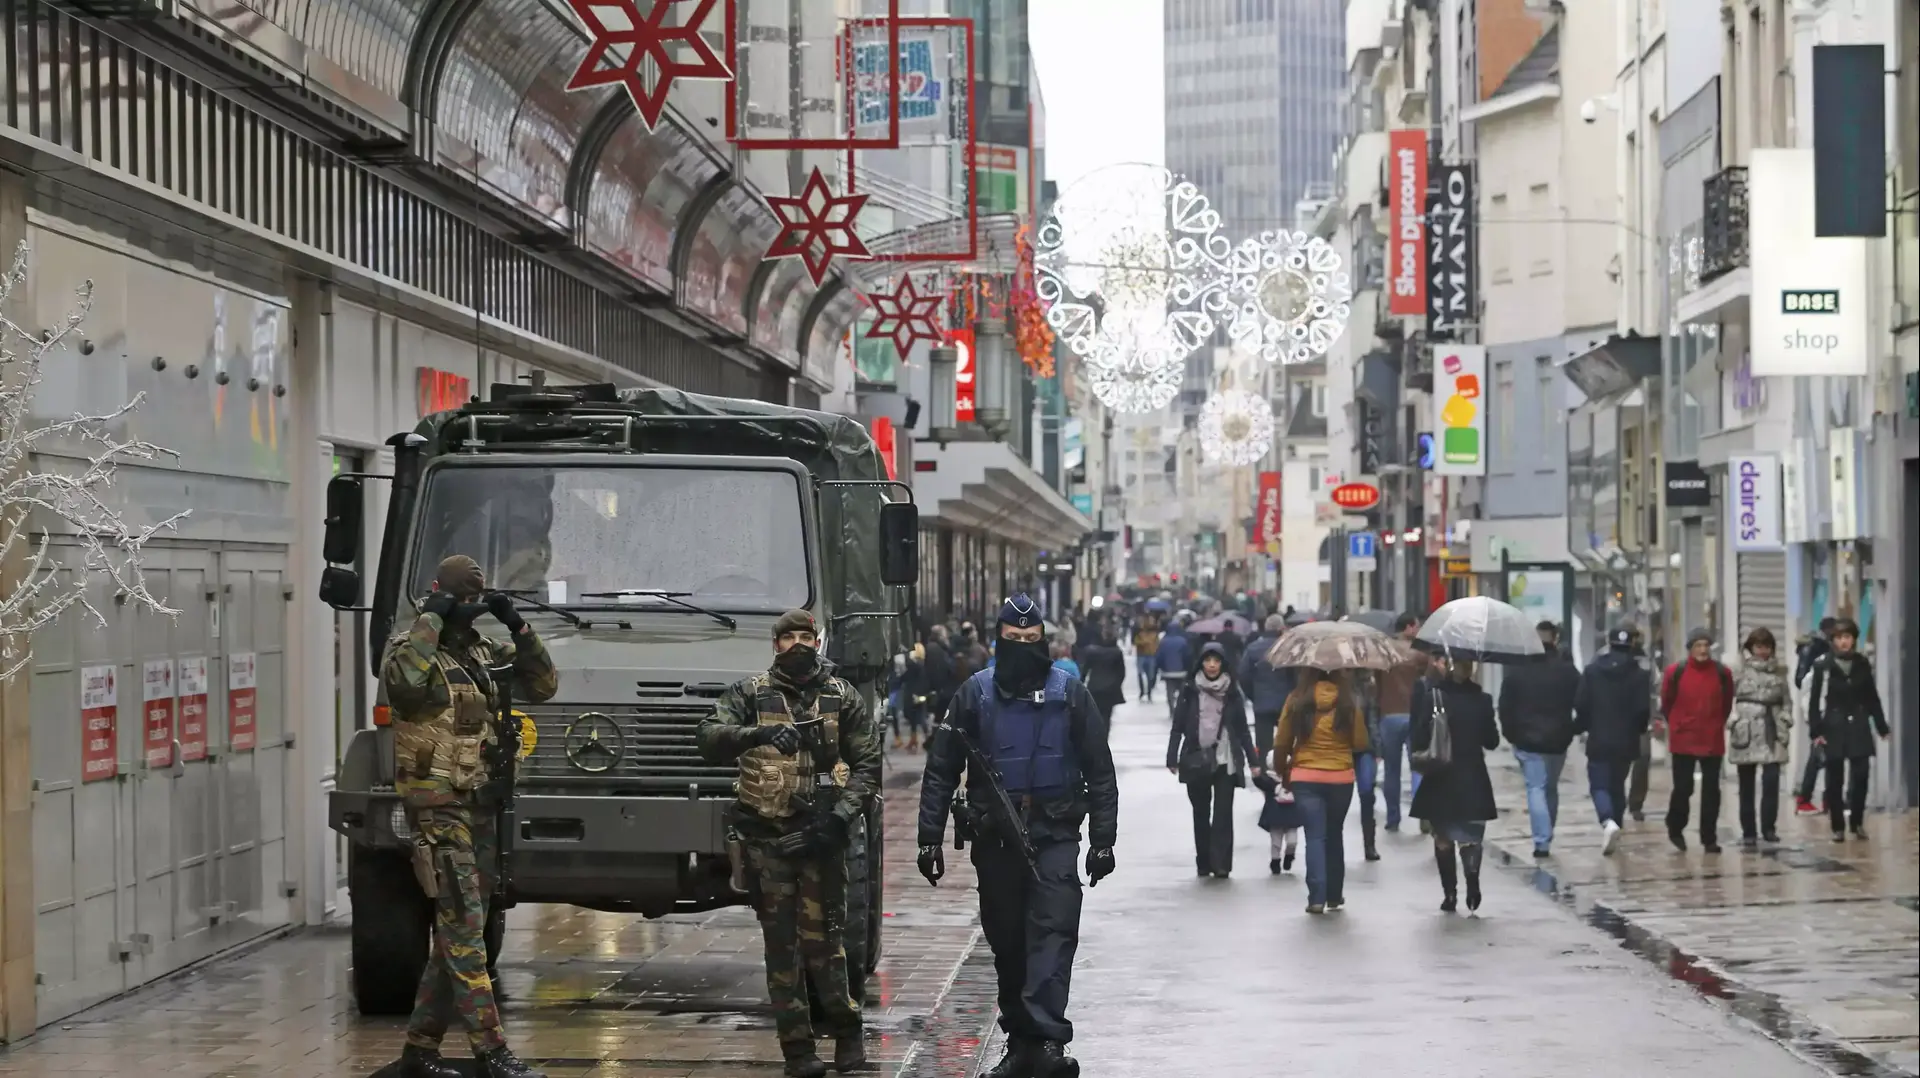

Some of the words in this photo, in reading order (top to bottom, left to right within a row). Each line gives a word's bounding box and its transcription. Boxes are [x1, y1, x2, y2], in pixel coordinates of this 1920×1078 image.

[1397, 148, 1420, 241] Discount
[1395, 243, 1416, 296] Shoe
[1447, 170, 1467, 312] MANO
[1785, 293, 1836, 311] BASE
[1783, 328, 1839, 355] shop
[1739, 460, 1761, 541] claire's
